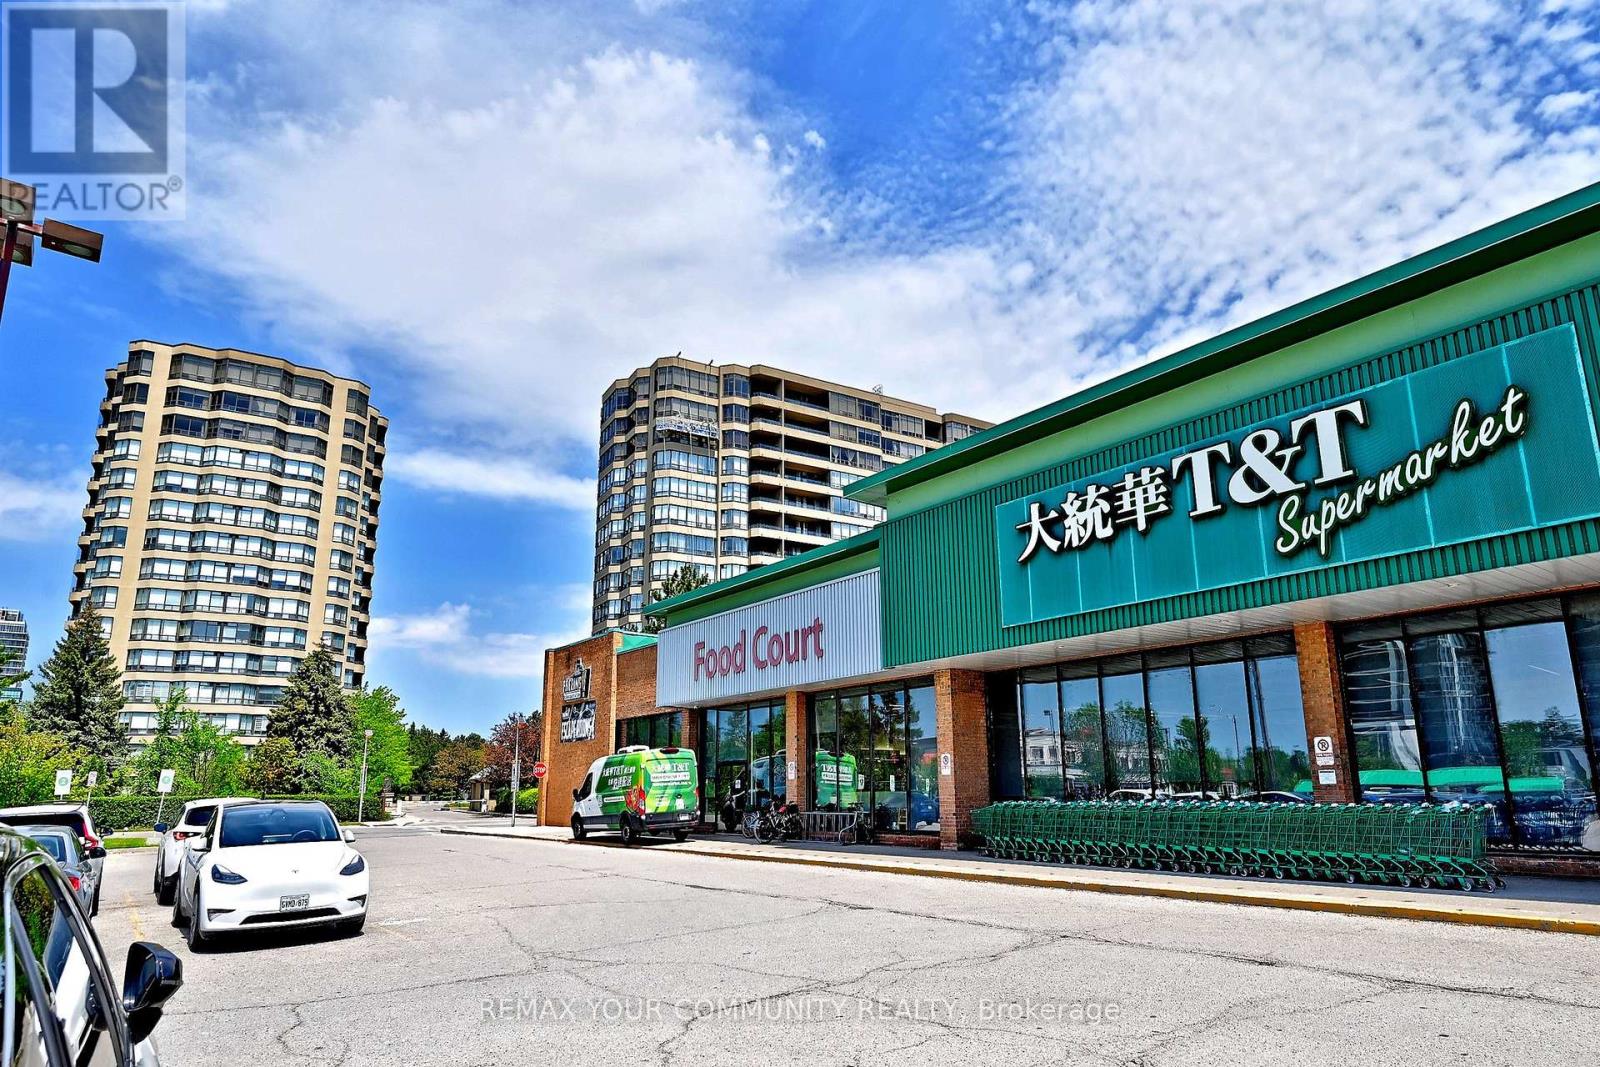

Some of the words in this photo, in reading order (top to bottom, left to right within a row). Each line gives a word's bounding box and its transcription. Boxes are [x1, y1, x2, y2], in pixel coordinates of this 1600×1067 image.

[1171, 400, 1366, 518] T&T
[1275, 386, 1526, 556] Supermarket
[1016, 466, 1169, 563] 大統華
[694, 629, 746, 682] Food
[752, 616, 824, 669] Court
